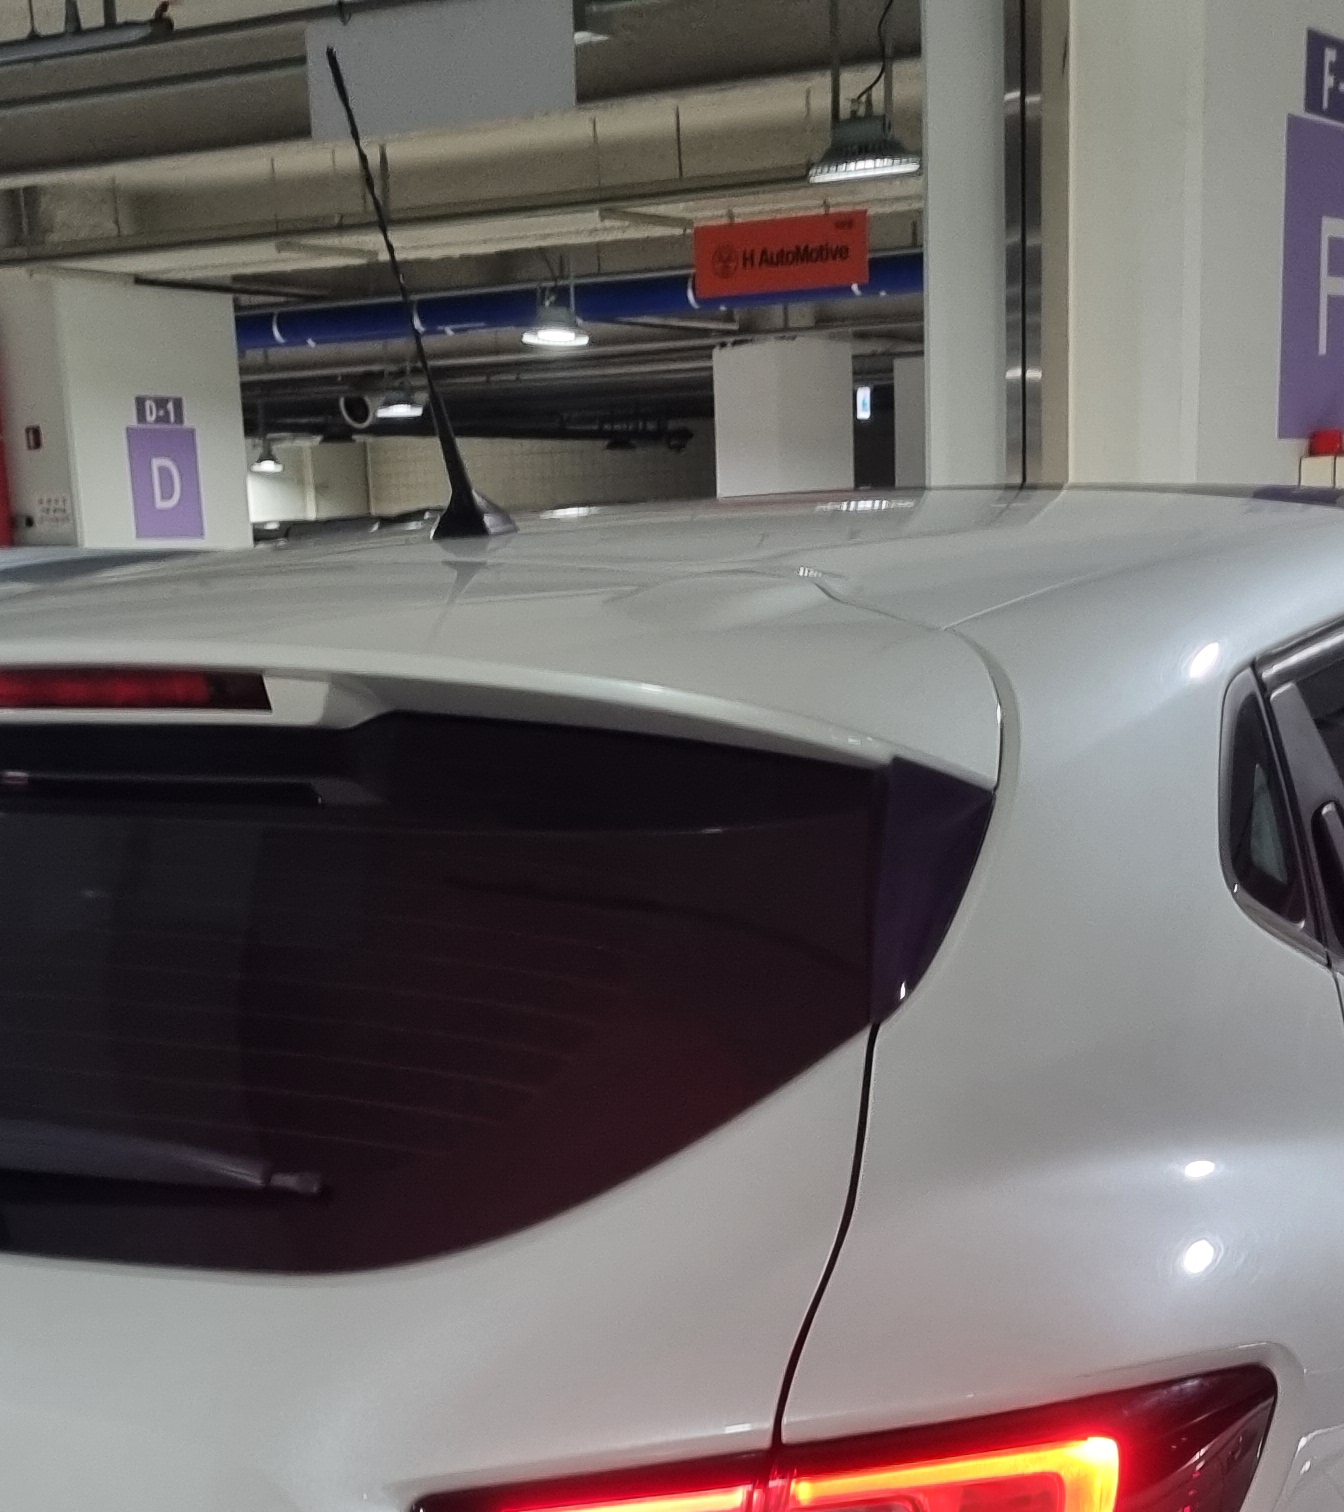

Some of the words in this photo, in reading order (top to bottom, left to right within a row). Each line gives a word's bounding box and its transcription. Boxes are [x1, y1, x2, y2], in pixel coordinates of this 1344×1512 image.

[741, 249, 756, 269] H
[758, 242, 850, 268] AutoMotive
[144, 398, 176, 424] D-1
[150, 456, 182, 510] D
